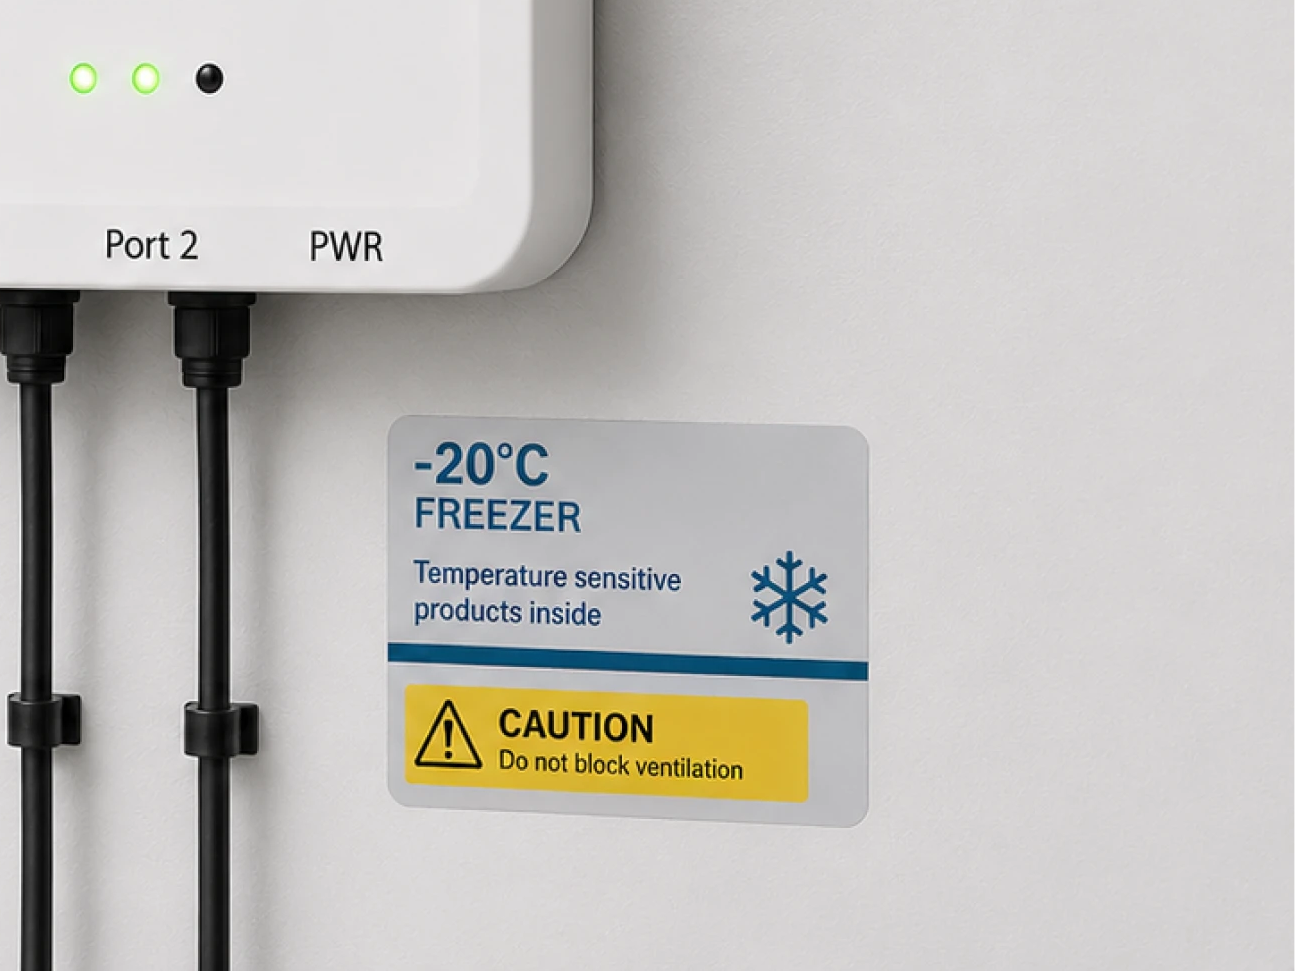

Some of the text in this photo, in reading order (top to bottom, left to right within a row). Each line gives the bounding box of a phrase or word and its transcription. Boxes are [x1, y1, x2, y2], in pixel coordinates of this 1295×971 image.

[106, 228, 199, 260] Port 2
[310, 230, 384, 262] PWR
[414, 441, 549, 487] -20°C
[415, 496, 582, 533] FREEZER
[414, 559, 682, 591] Temperature sensitive
[414, 598, 602, 626] products inside
[498, 708, 654, 743] CAUTION
[499, 749, 744, 780] Do not block ventilation
